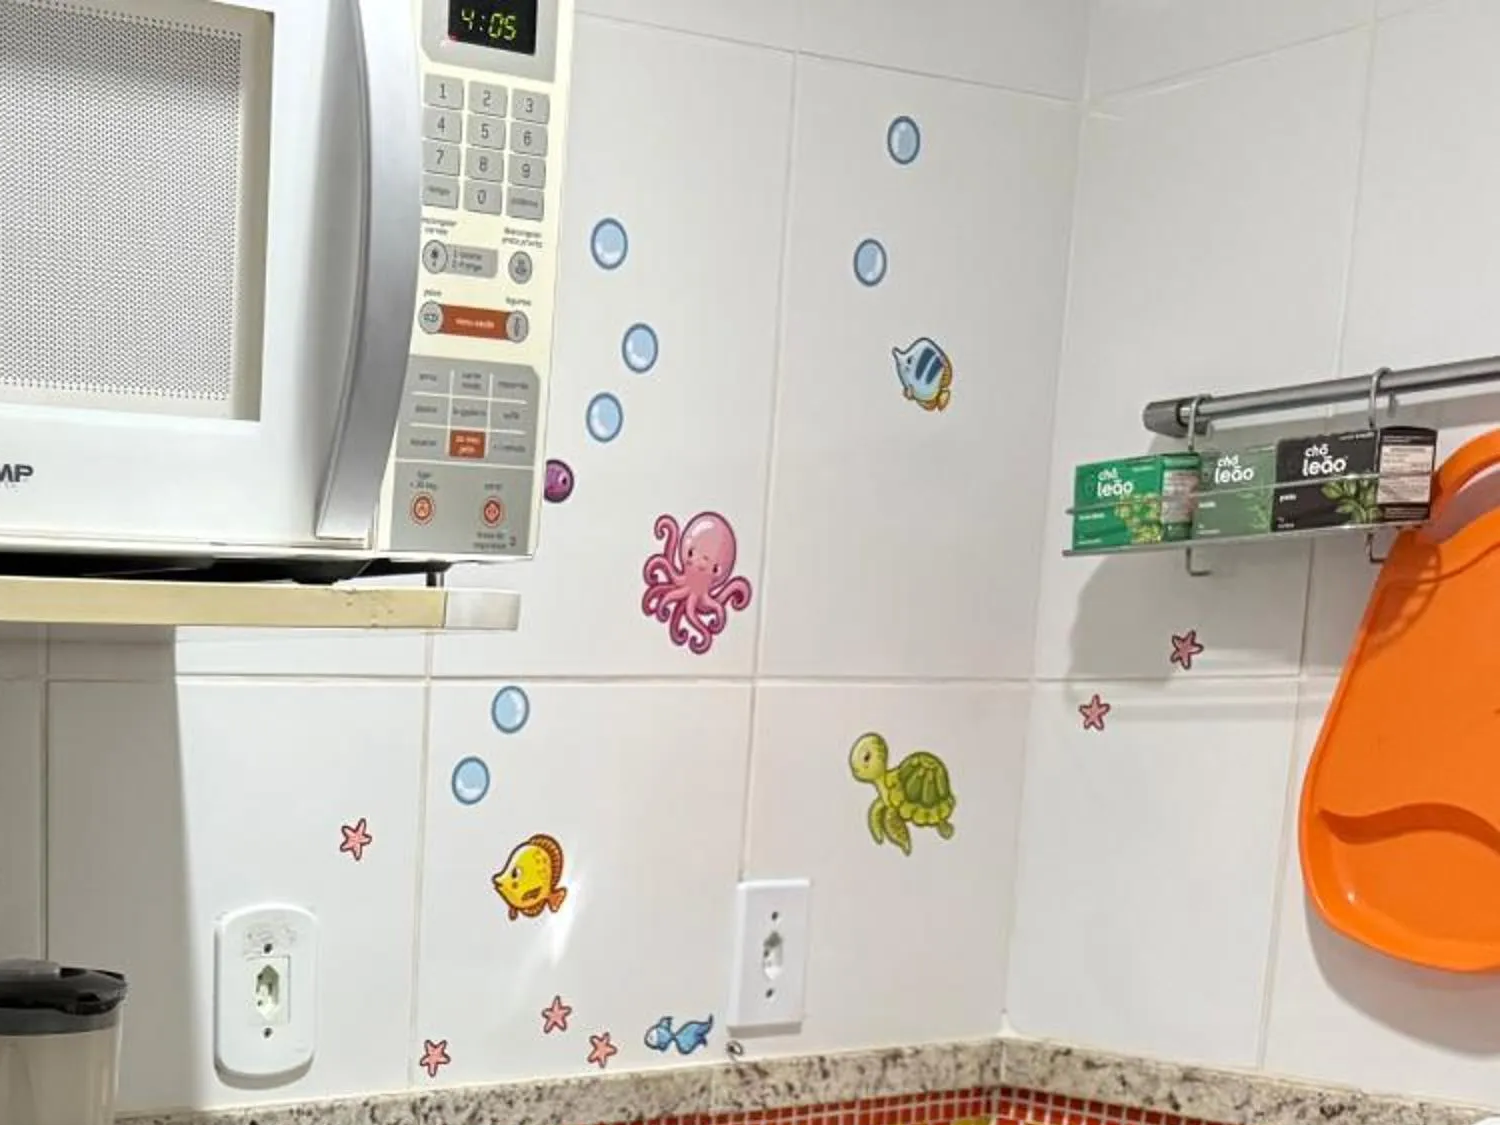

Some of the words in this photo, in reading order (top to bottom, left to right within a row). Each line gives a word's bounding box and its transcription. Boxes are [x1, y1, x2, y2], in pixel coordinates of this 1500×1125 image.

[460, 8, 517, 41] 4:05
[438, 83, 447, 99] 1
[482, 90, 492, 107] 2
[524, 98, 534, 113] 3
[436, 117, 446, 132] 4
[480, 123, 489, 139] 5
[522, 130, 532, 146] 6
[435, 149, 445, 164] 7
[478, 156, 488, 172] 8
[521, 163, 531, 178] 9
[476, 189, 487, 205] 0
[1301, 455, 1347, 477] leão
[1214, 465, 1255, 484] leão
[1096, 479, 1134, 497] leão
